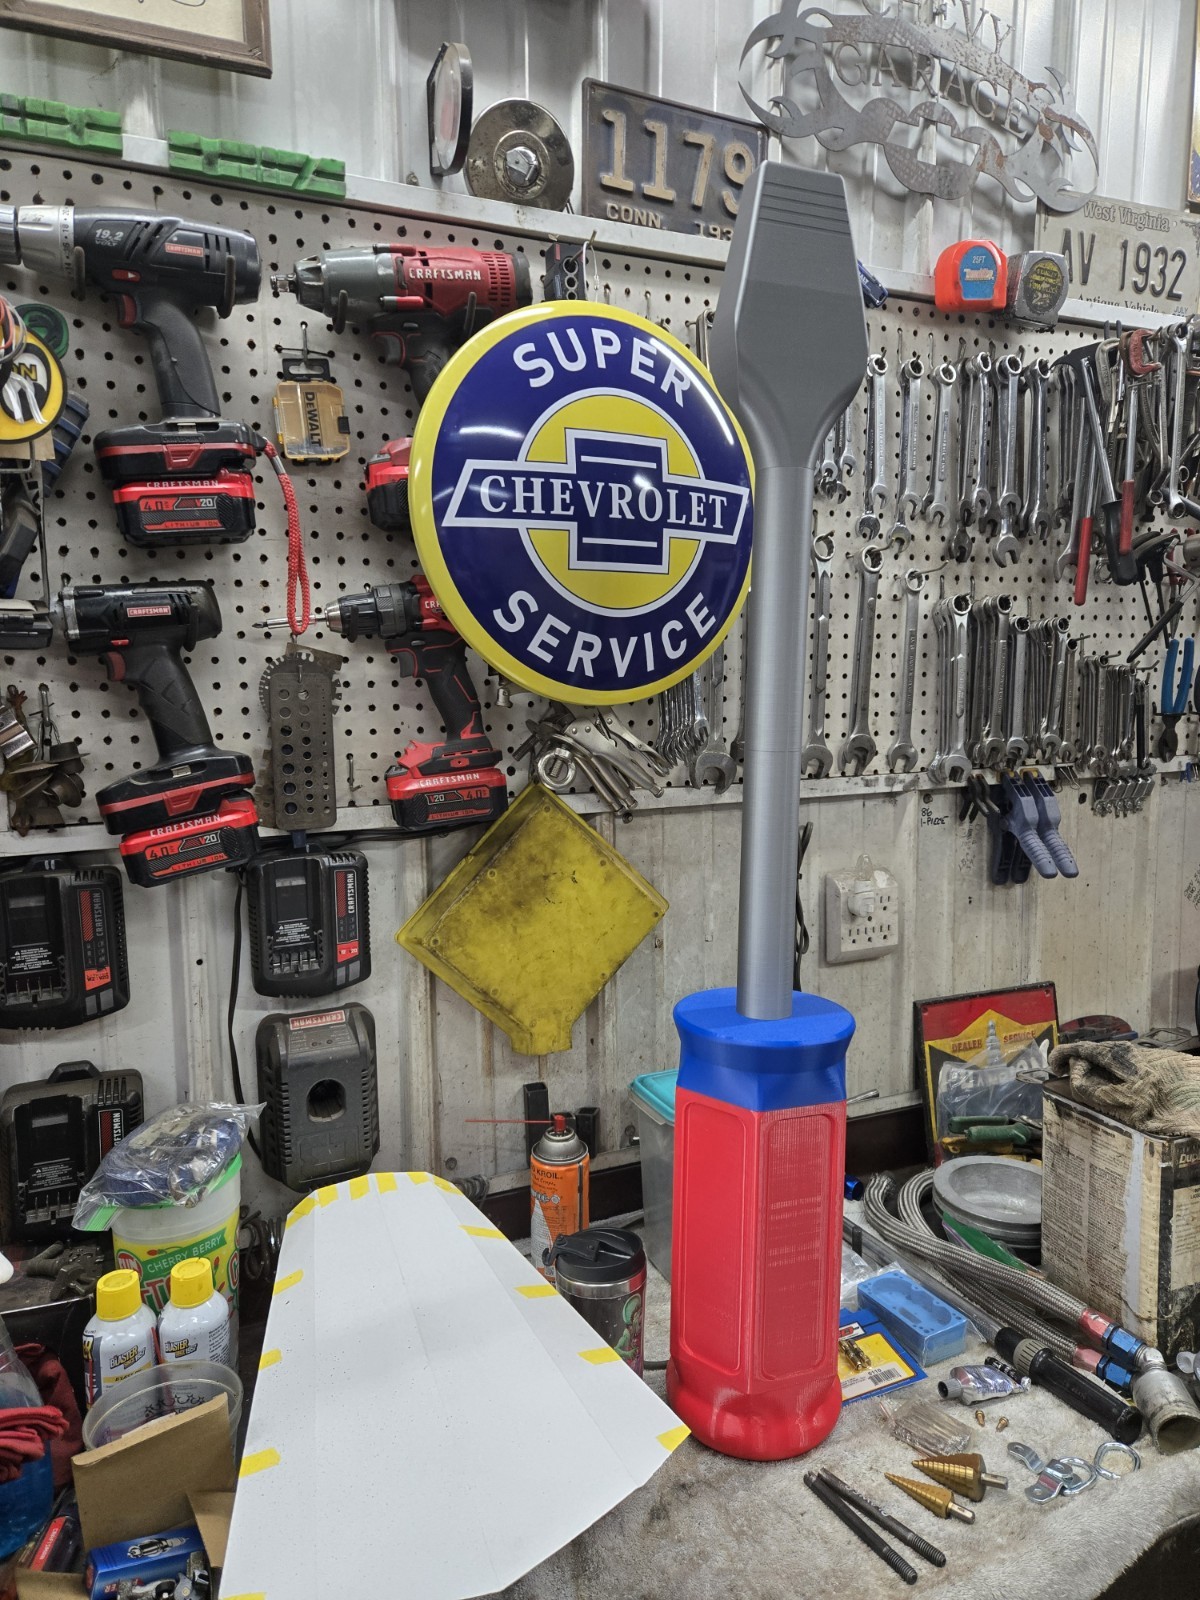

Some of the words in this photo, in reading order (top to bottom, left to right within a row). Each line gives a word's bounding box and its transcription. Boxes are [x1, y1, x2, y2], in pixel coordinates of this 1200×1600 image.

[834, 42, 1029, 141] GARAGE
[1083, 200, 1116, 222] West
[1119, 206, 1170, 232] Virginia
[95, 228, 124, 241] 19.2
[409, 268, 481, 280] CRAFTSMAN
[1062, 228, 1096, 286] AV
[1120, 239, 1187, 301] 1932
[513, 327, 691, 407] SUPER
[146, 480, 219, 488] CRAFTSMAN
[480, 475, 728, 529] CHEVROLET
[130, 607, 169, 615] CRAFTSMAN
[493, 590, 716, 678] SERVICE
[419, 773, 480, 787] CRAFTSMAN
[921, 807, 933, 816] 86
[149, 814, 221, 837] CRAFTSMAN
[149, 846, 169, 860] 4.0
[347, 873, 355, 914] CRAFTSMAN
[93, 892, 104, 937] CRAFTSMAN
[293, 1013, 341, 1027] CRAFTSMAN
[952, 1039, 983, 1053] DEALER
[1003, 1030, 1036, 1043] SERVICE
[147, 1251, 188, 1273] CHERRY
[192, 1235, 222, 1257] BERRY
